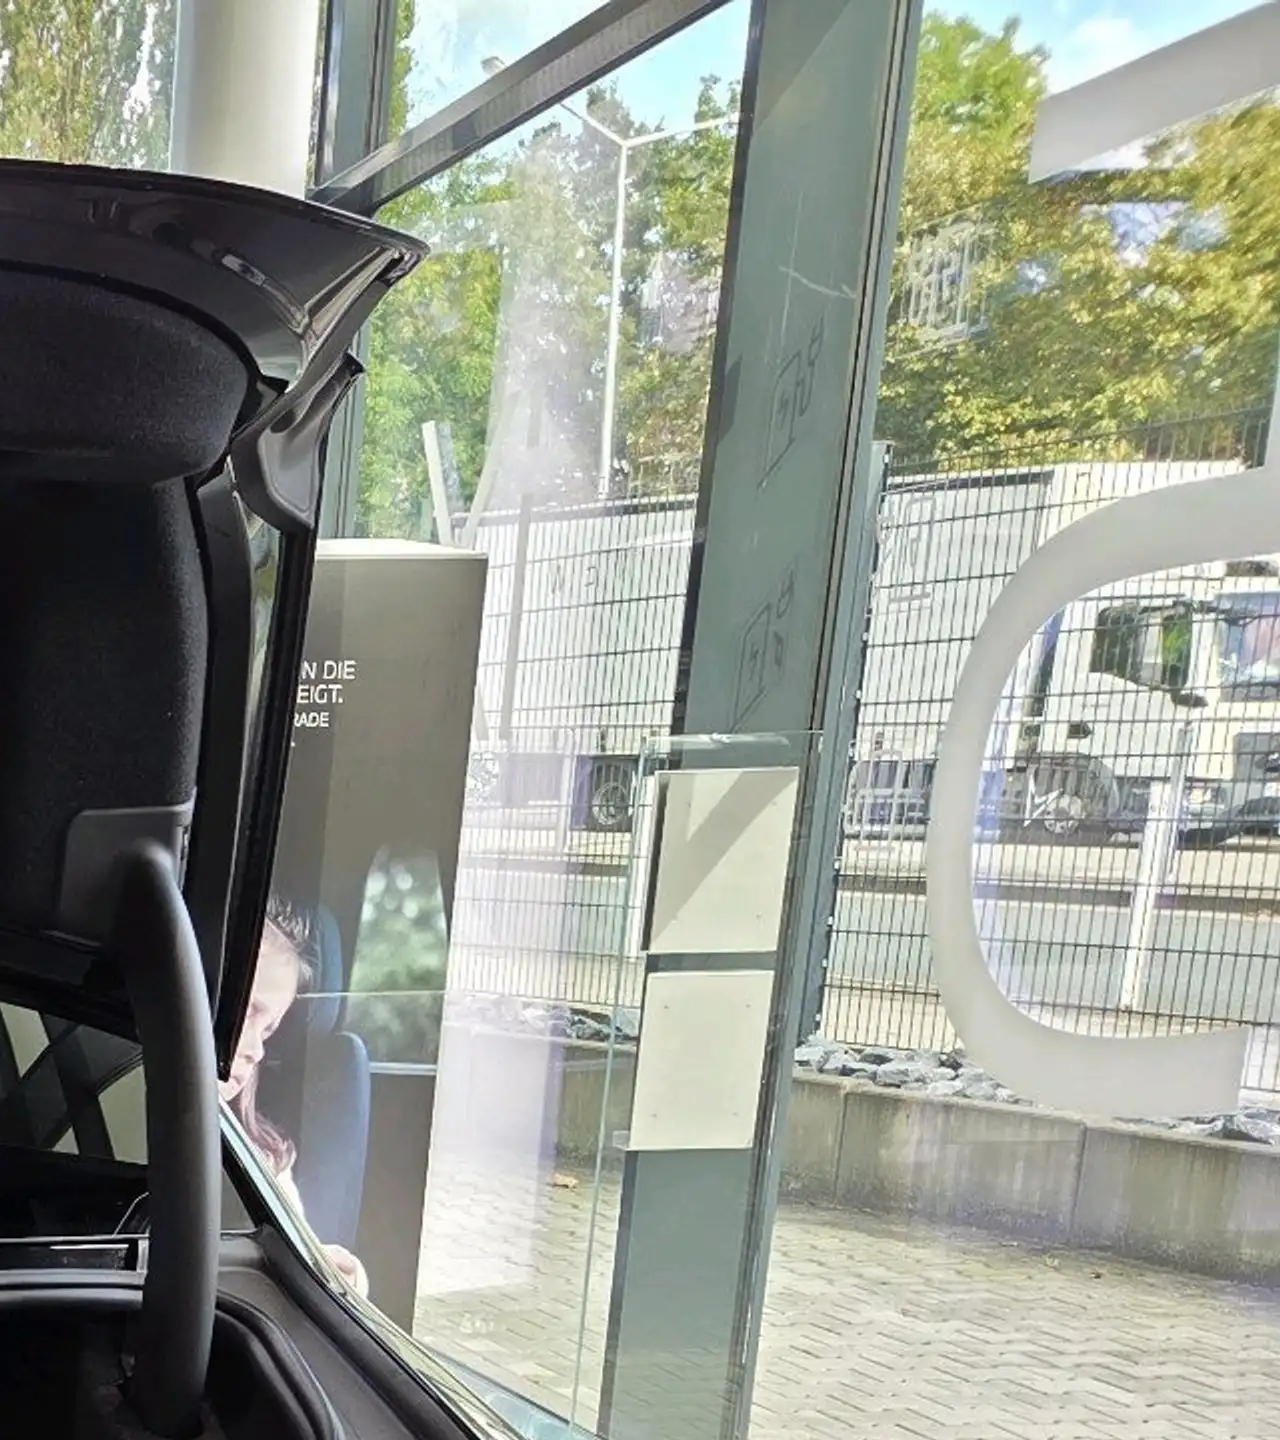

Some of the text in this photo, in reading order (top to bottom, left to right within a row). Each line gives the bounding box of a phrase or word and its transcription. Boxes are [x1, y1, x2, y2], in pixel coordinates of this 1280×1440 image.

[301, 660, 357, 680] N DIE
[296, 684, 344, 704] EIGT.
